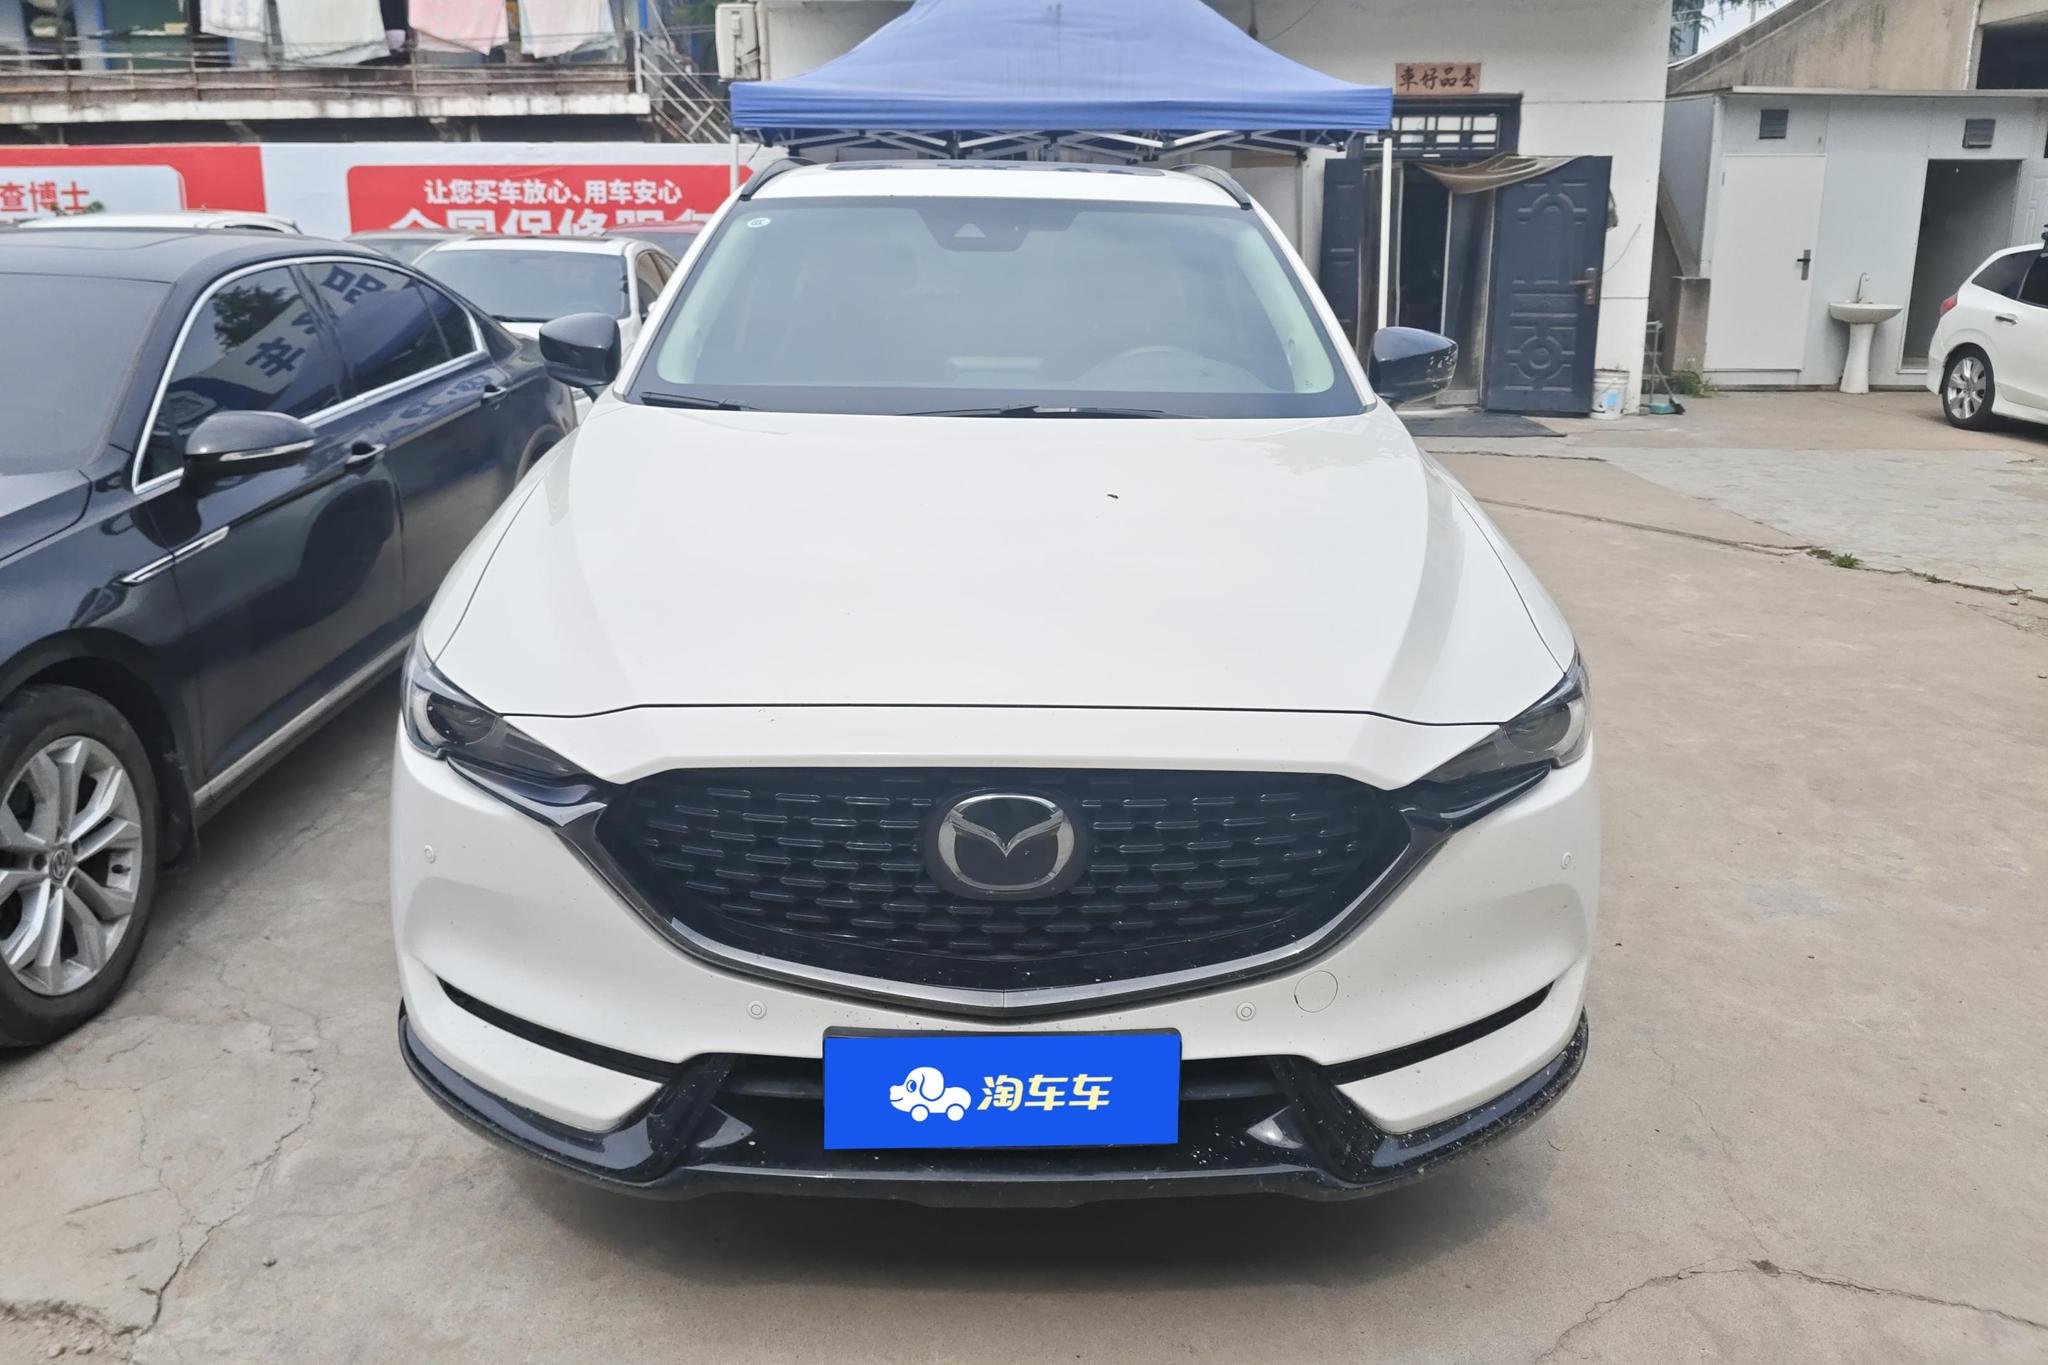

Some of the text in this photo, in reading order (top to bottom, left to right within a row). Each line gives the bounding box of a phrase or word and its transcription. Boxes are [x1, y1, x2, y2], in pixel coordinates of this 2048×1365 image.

[423, 178, 683, 205] 让您买车放心、用车安心
